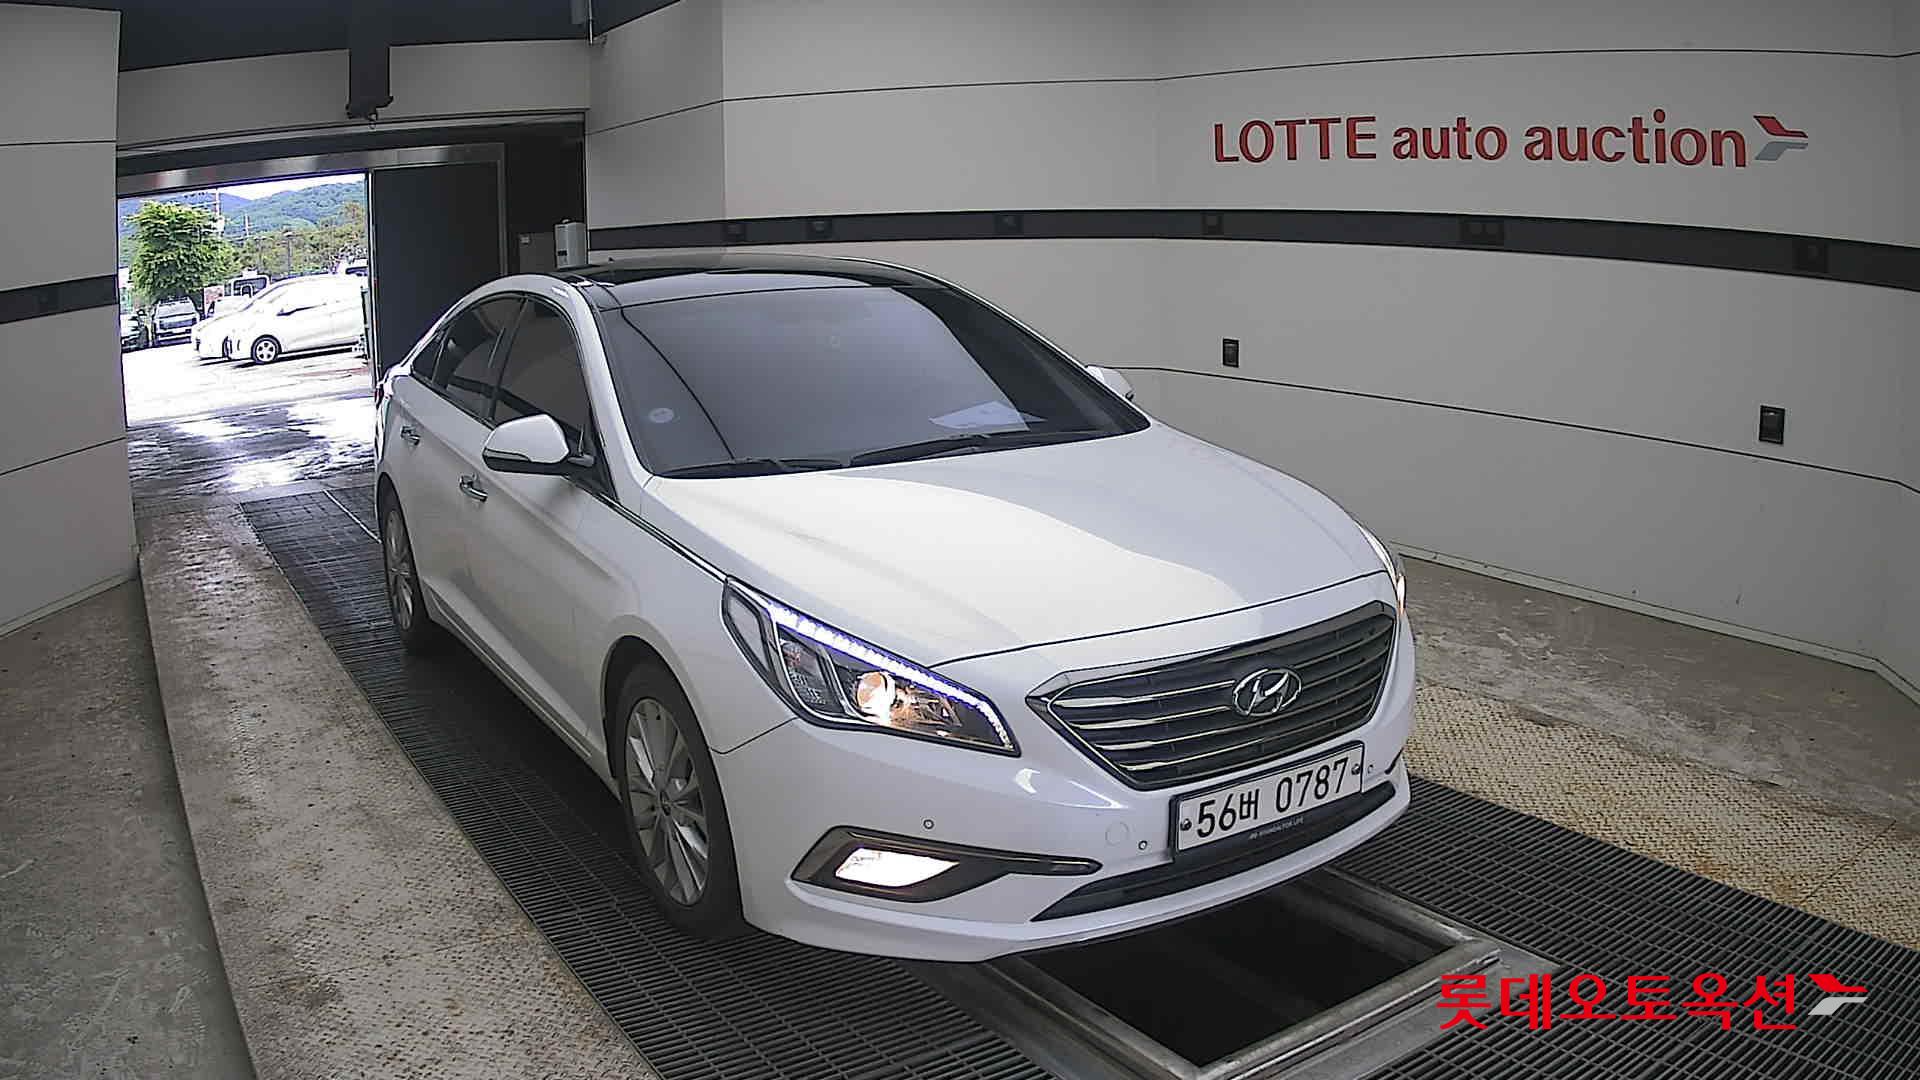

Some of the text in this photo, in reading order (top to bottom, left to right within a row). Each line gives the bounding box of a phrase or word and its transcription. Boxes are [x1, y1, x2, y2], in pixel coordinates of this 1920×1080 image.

[1214, 109, 1747, 167] LOTTE auto auction
[1197, 788, 1260, 838] 56버
[1275, 757, 1349, 813] 0787
